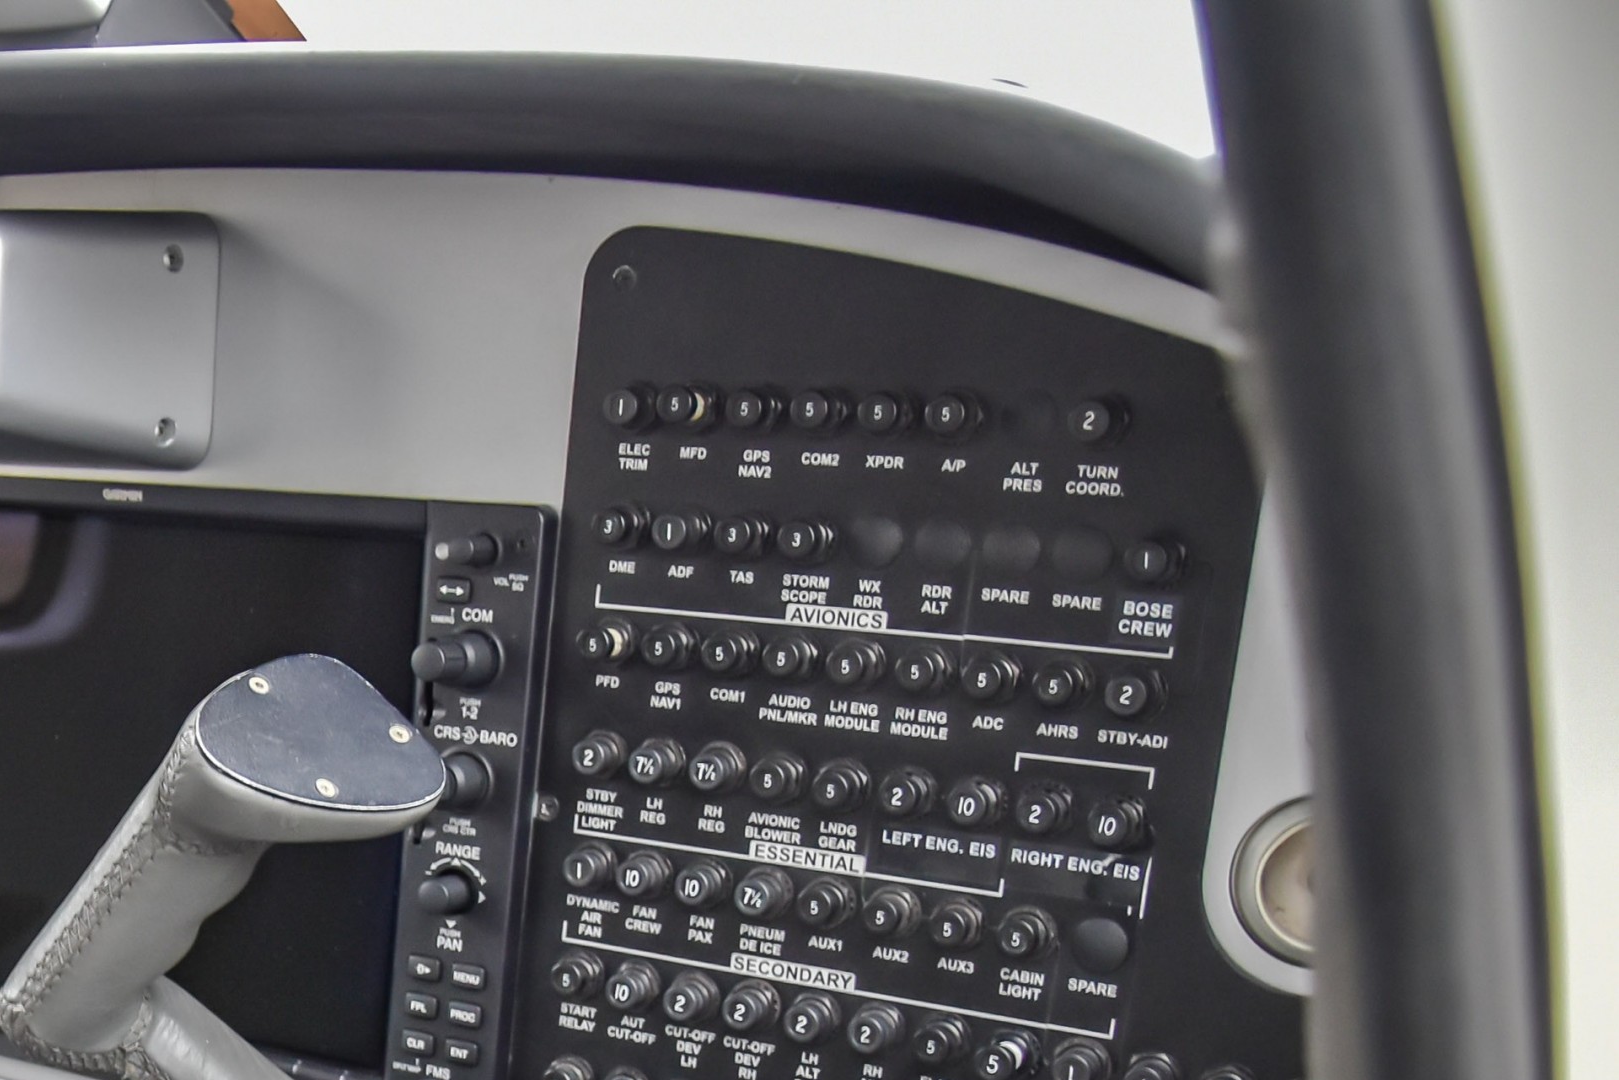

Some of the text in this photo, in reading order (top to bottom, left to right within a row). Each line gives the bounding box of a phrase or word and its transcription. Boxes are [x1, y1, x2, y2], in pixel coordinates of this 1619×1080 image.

[619, 443, 650, 456] ELEC
[680, 447, 707, 460] MFD
[743, 450, 770, 463] GPS
[619, 458, 648, 471] TRIM
[801, 452, 839, 467] COM2
[865, 455, 904, 469] XPDR
[941, 458, 966, 472] A/P
[738, 465, 772, 478] NAV2
[1011, 462, 1039, 476] ALT
[1078, 465, 1118, 479] TURN
[1003, 478, 1042, 492] PRES
[609, 560, 635, 574] DME
[668, 565, 694, 578] ADF
[730, 571, 754, 584] TAS
[783, 574, 830, 589] STORM
[859, 579, 881, 593] WX
[922, 585, 952, 599] RDR
[781, 589, 826, 604] SCOPE
[853, 595, 882, 609] RDR
[981, 588, 1030, 605] SPARE
[1052, 594, 1102, 611] SPARE
[462, 607, 493, 623] COM
[921, 601, 948, 615] ALT
[1123, 601, 1173, 619] BOSE
[790, 608, 883, 629] AVIONICS
[1118, 620, 1172, 638] CREW
[596, 675, 619, 688] PFD
[655, 681, 680, 695] GPS
[650, 695, 681, 710] NAV1
[710, 688, 745, 703] COM1
[769, 694, 811, 710] AUDIO
[830, 700, 878, 716] LH ENG
[895, 707, 947, 724] RH ENG
[759, 708, 817, 726] PNL/MKR
[824, 714, 880, 733] MODULE
[972, 716, 1003, 731] ADC
[434, 724, 460, 741] CRS
[479, 729, 518, 747] BARO
[890, 722, 948, 740] MODULE
[1037, 724, 1078, 739] AHRS
[1097, 730, 1168, 749] STBY-ADI
[646, 797, 662, 810] LH
[640, 811, 666, 825] REG
[704, 805, 722, 818] RH
[698, 818, 725, 833] REG
[748, 813, 800, 830] AVIONIC
[745, 827, 801, 844] BLOWER
[820, 822, 857, 837] LNDG
[436, 841, 481, 860] RANGE
[819, 837, 856, 852] GEAR
[882, 830, 922, 848] LEFT
[969, 842, 996, 859] EIS
[755, 845, 860, 872] ESSENTIAL
[1011, 849, 1064, 869] RIGHT
[1113, 864, 1140, 880] EIS
[633, 905, 657, 919] FAN
[625, 918, 662, 934] CREW
[689, 915, 714, 930] FAN
[688, 929, 713, 944] PAX
[740, 924, 785, 942] PNEUM
[437, 936, 463, 952] PAN
[740, 939, 781, 956] DE ICE
[808, 936, 842, 952] AUX1
[873, 947, 909, 963] AUX2
[734, 956, 853, 989] SECONDARY
[937, 958, 974, 974] AUX3
[453, 970, 480, 985] MENU
[1000, 968, 1044, 986] CABIN
[998, 983, 1042, 1001] LIGHT
[1068, 978, 1117, 998] SPARE
[406, 1037, 425, 1050] CLR
[451, 1047, 468, 1060] ENT
[426, 1064, 451, 1080] FMS
[863, 1065, 883, 1078] RH
